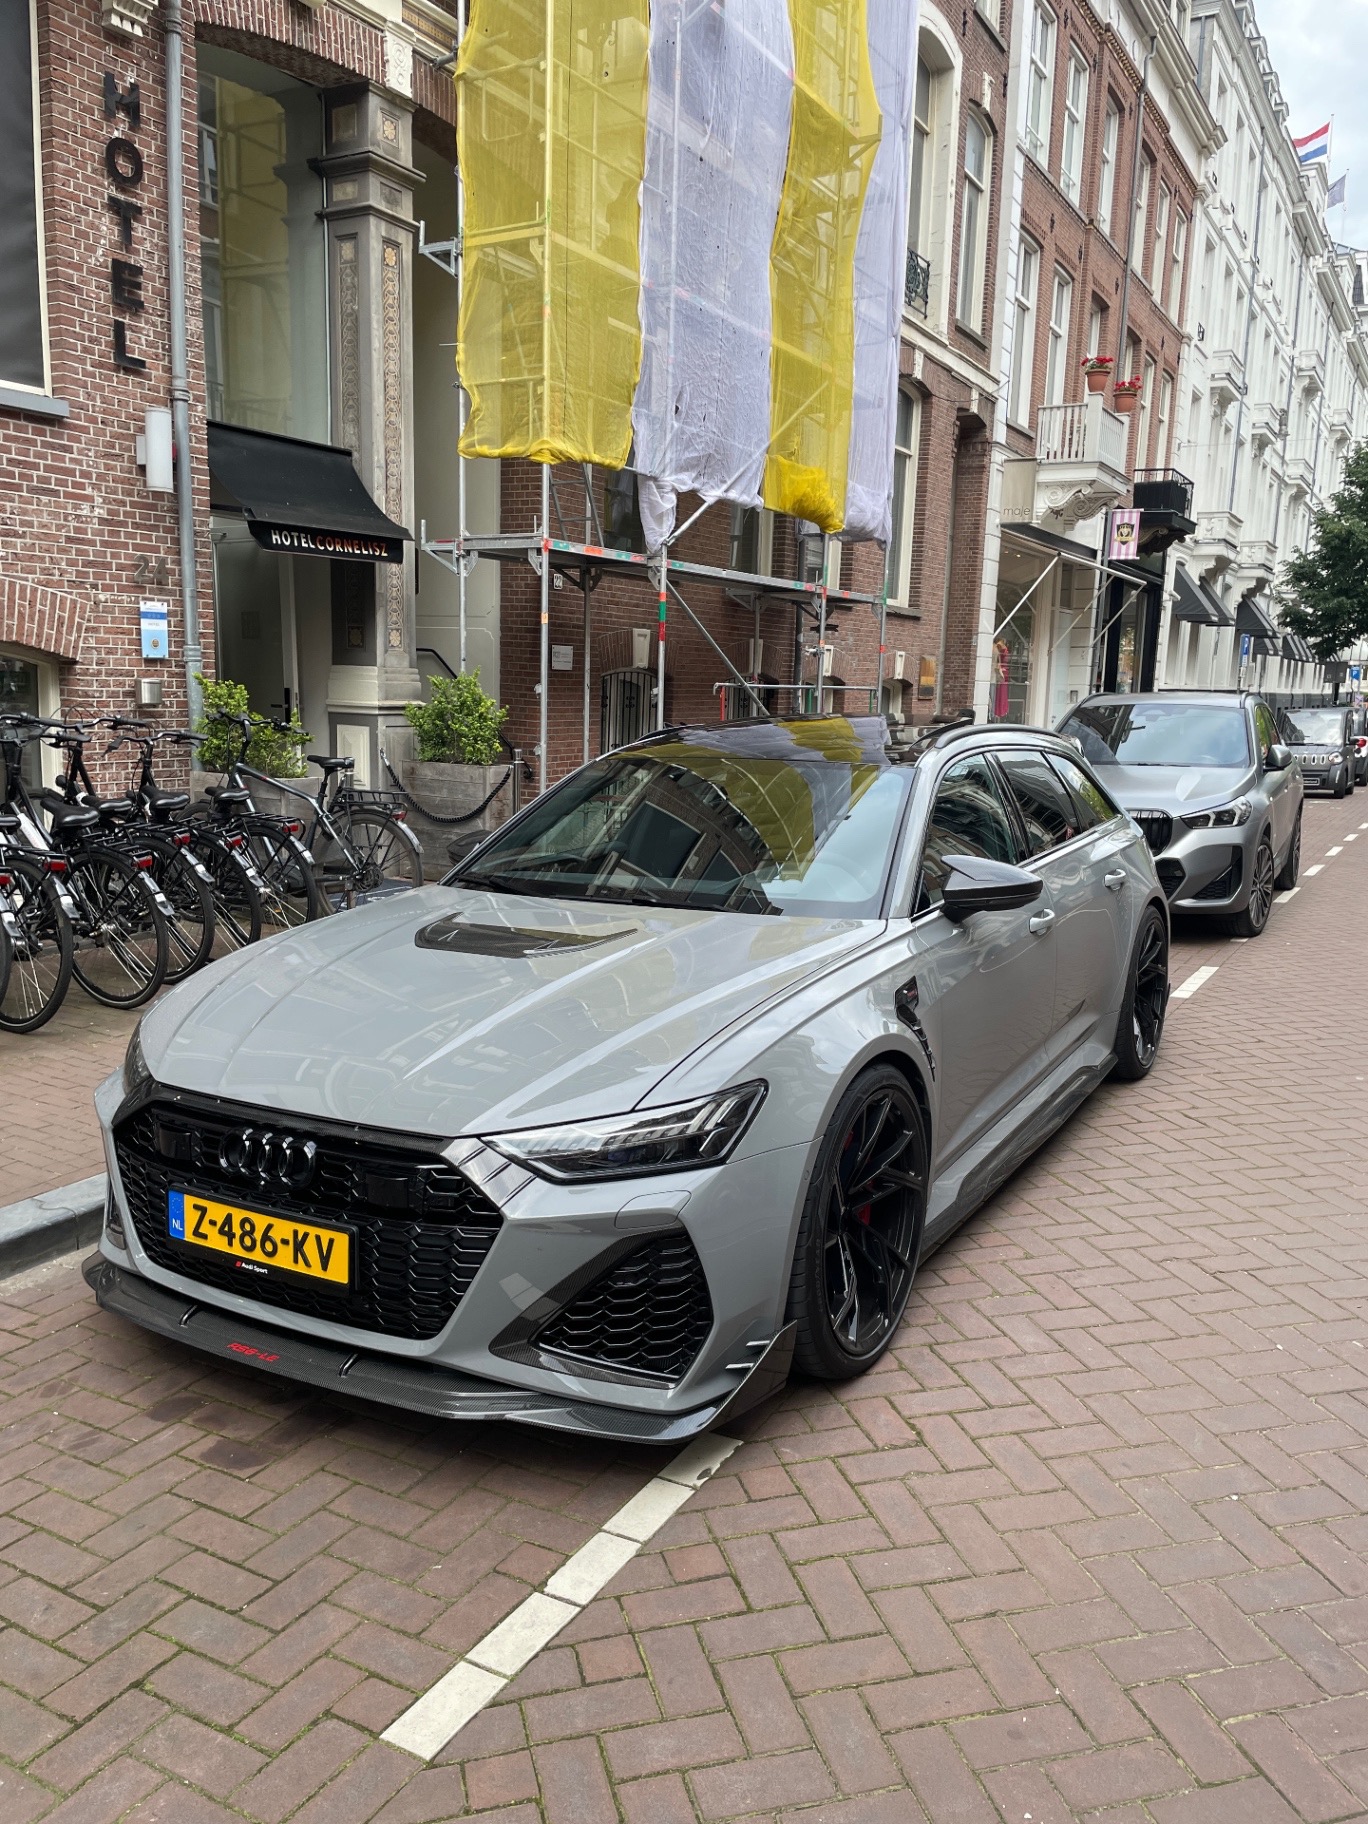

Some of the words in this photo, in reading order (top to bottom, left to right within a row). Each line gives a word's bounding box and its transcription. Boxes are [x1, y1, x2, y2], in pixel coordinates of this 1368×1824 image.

[104, 70, 146, 369] HOTEL
[1003, 506, 1031, 517] maje
[134, 554, 170, 587] 24
[172, 1219, 183, 1231] NL
[192, 1203, 335, 1272] Z-486-KV
[241, 1262, 253, 1270] Audi
[254, 1265, 268, 1274] Sport
